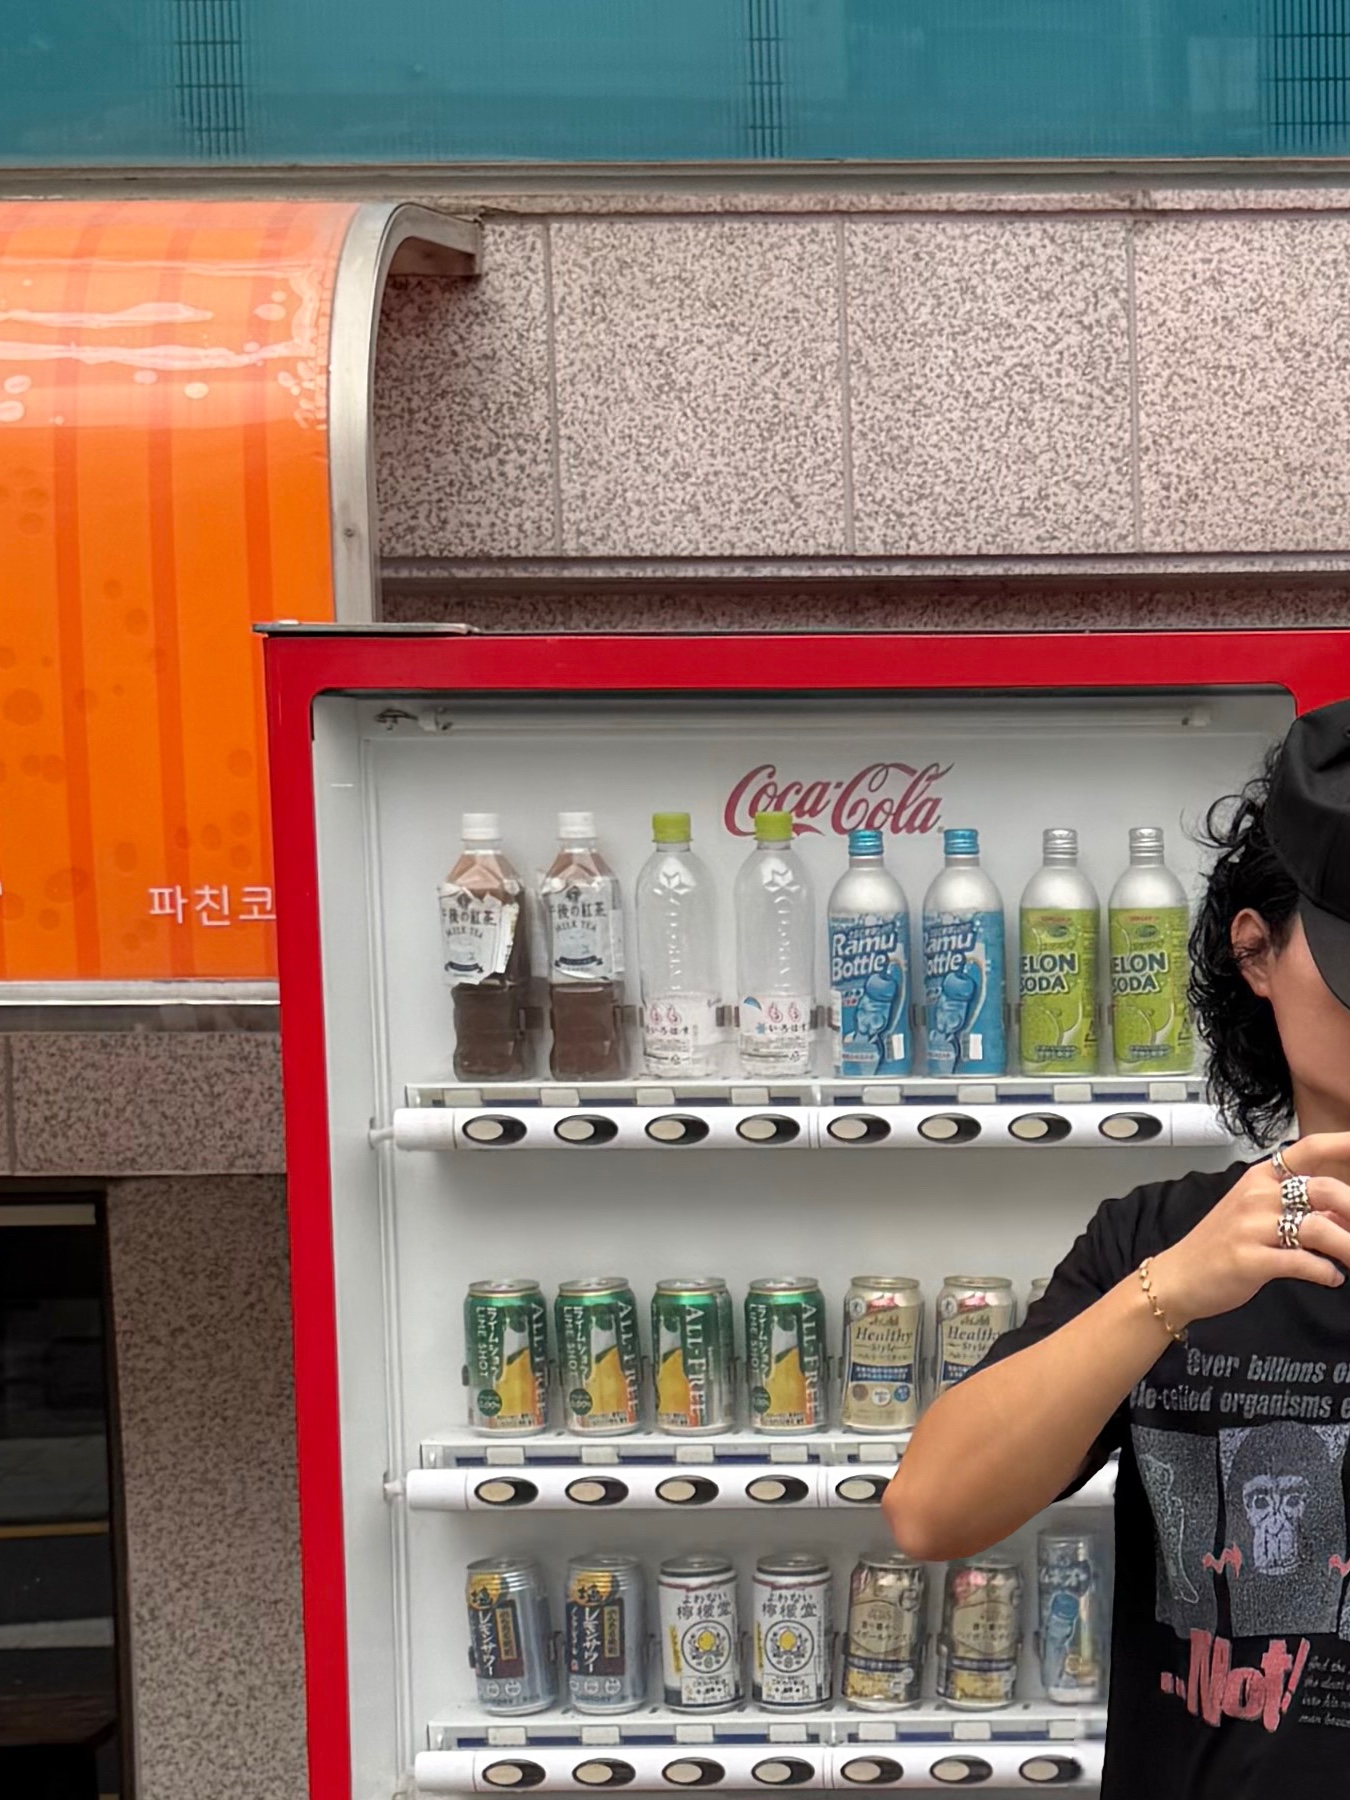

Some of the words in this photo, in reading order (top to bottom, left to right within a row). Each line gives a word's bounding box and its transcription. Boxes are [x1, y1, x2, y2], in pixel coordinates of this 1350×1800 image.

[724, 762, 955, 837] Coca-Cola
[148, 884, 277, 926] 파친코
[832, 932, 895, 957] Ramu
[924, 932, 974, 954] amu
[926, 951, 963, 976] ottle
[1020, 953, 1076, 975] ELON
[1110, 951, 1166, 974] ELON
[855, 1326, 912, 1344] Healthy
[685, 1304, 707, 1417] ALL-FREE
[801, 1302, 820, 1415] ALL-FREE
[1186, 1348, 1240, 1378] Over
[1247, 1354, 1327, 1384] billions
[1219, 1389, 1333, 1419] organisms
[478, 1609, 497, 1677] レモンサワー
[582, 1606, 601, 1674] レモンサワー
